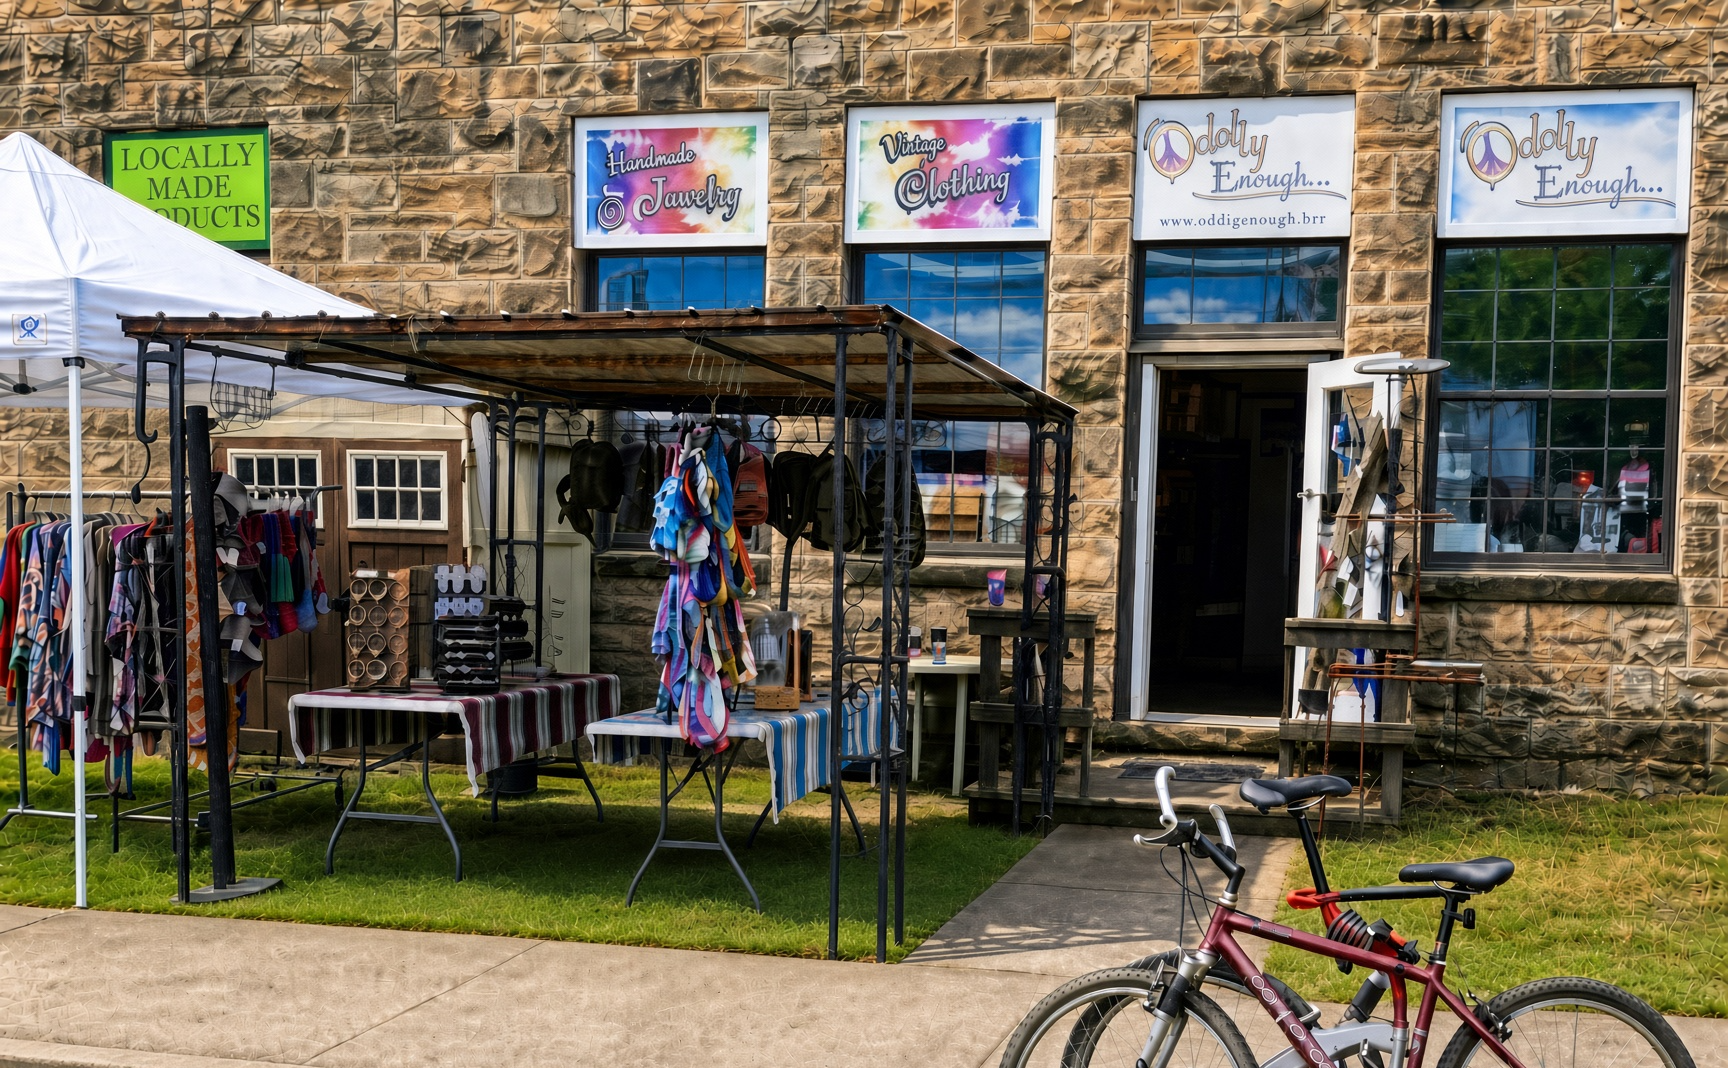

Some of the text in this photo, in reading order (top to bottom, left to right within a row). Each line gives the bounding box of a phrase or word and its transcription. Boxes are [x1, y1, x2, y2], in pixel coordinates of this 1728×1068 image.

[121, 142, 257, 171] LOCALLY
[606, 141, 696, 177] Handmade
[879, 131, 947, 164] Vintage
[147, 175, 231, 200] MADE
[895, 159, 1010, 212] Clothing
[154, 204, 260, 229] DUCTS
